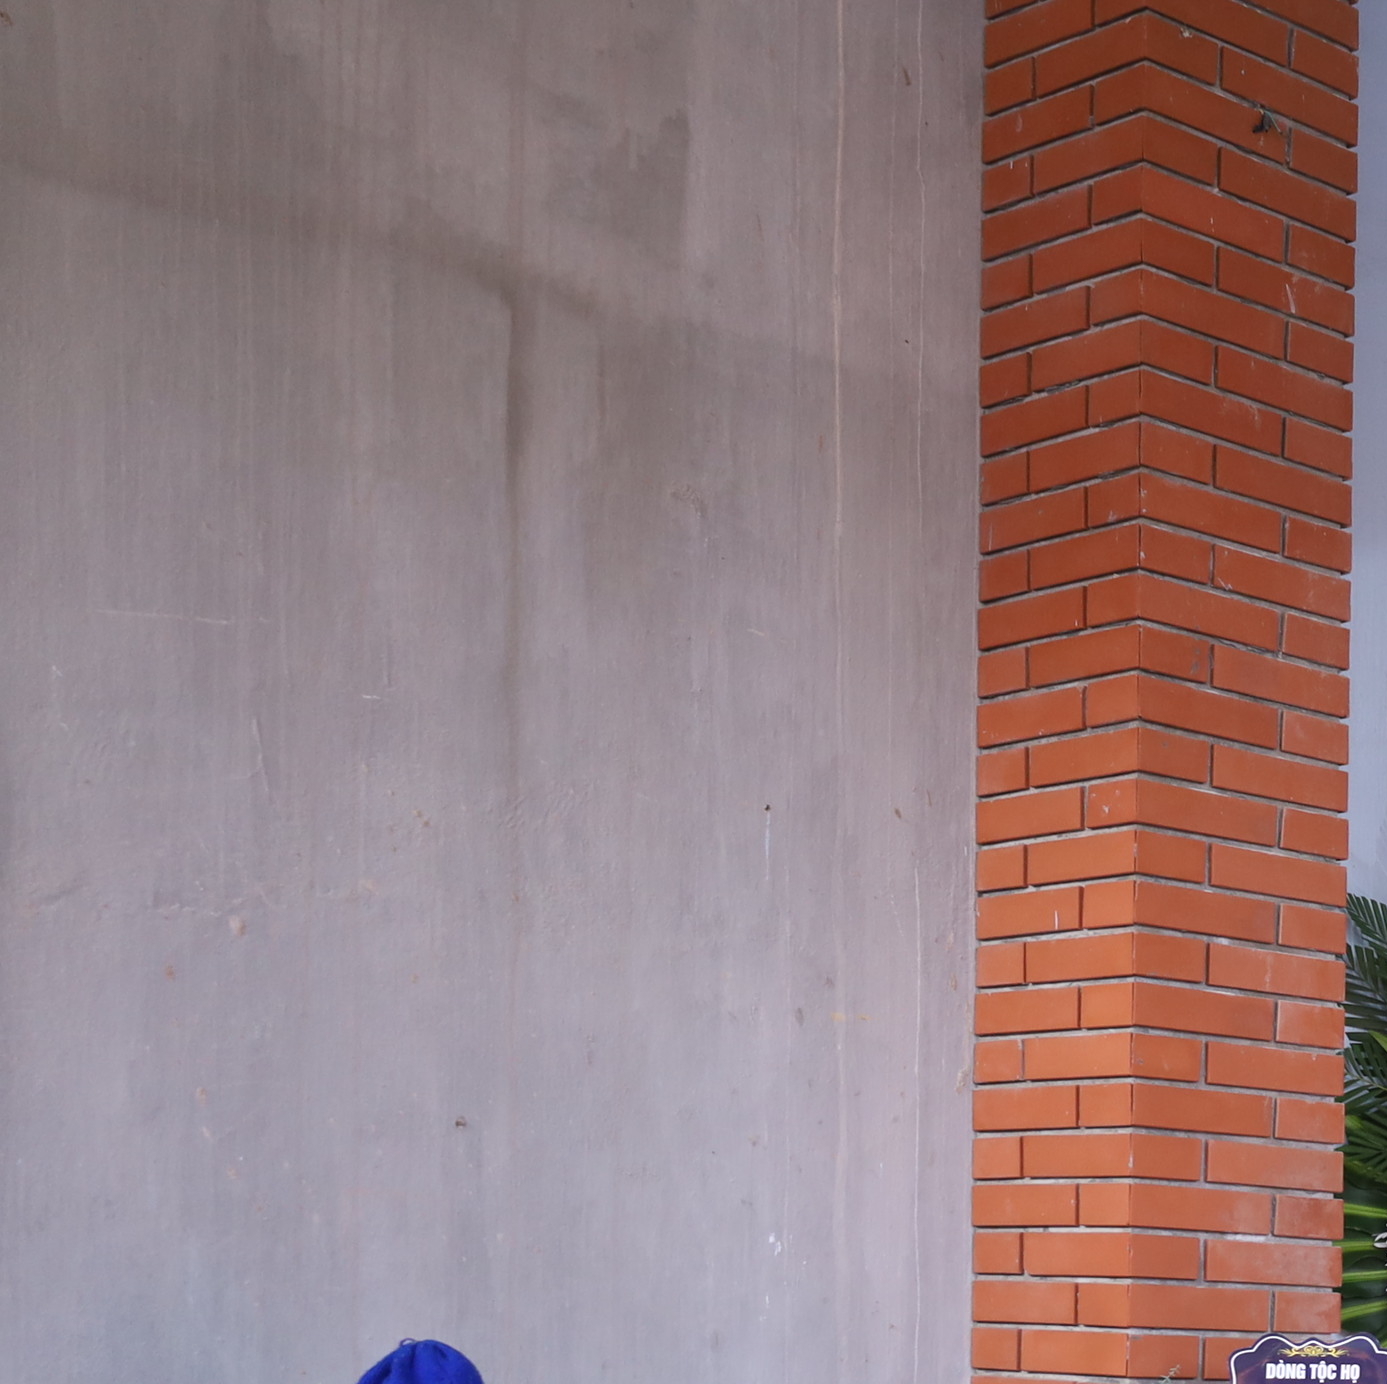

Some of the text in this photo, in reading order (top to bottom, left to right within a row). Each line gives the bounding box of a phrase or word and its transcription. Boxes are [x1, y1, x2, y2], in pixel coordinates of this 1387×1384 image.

[1265, 1359, 1361, 1384] DÒNG TỘC HỌ
